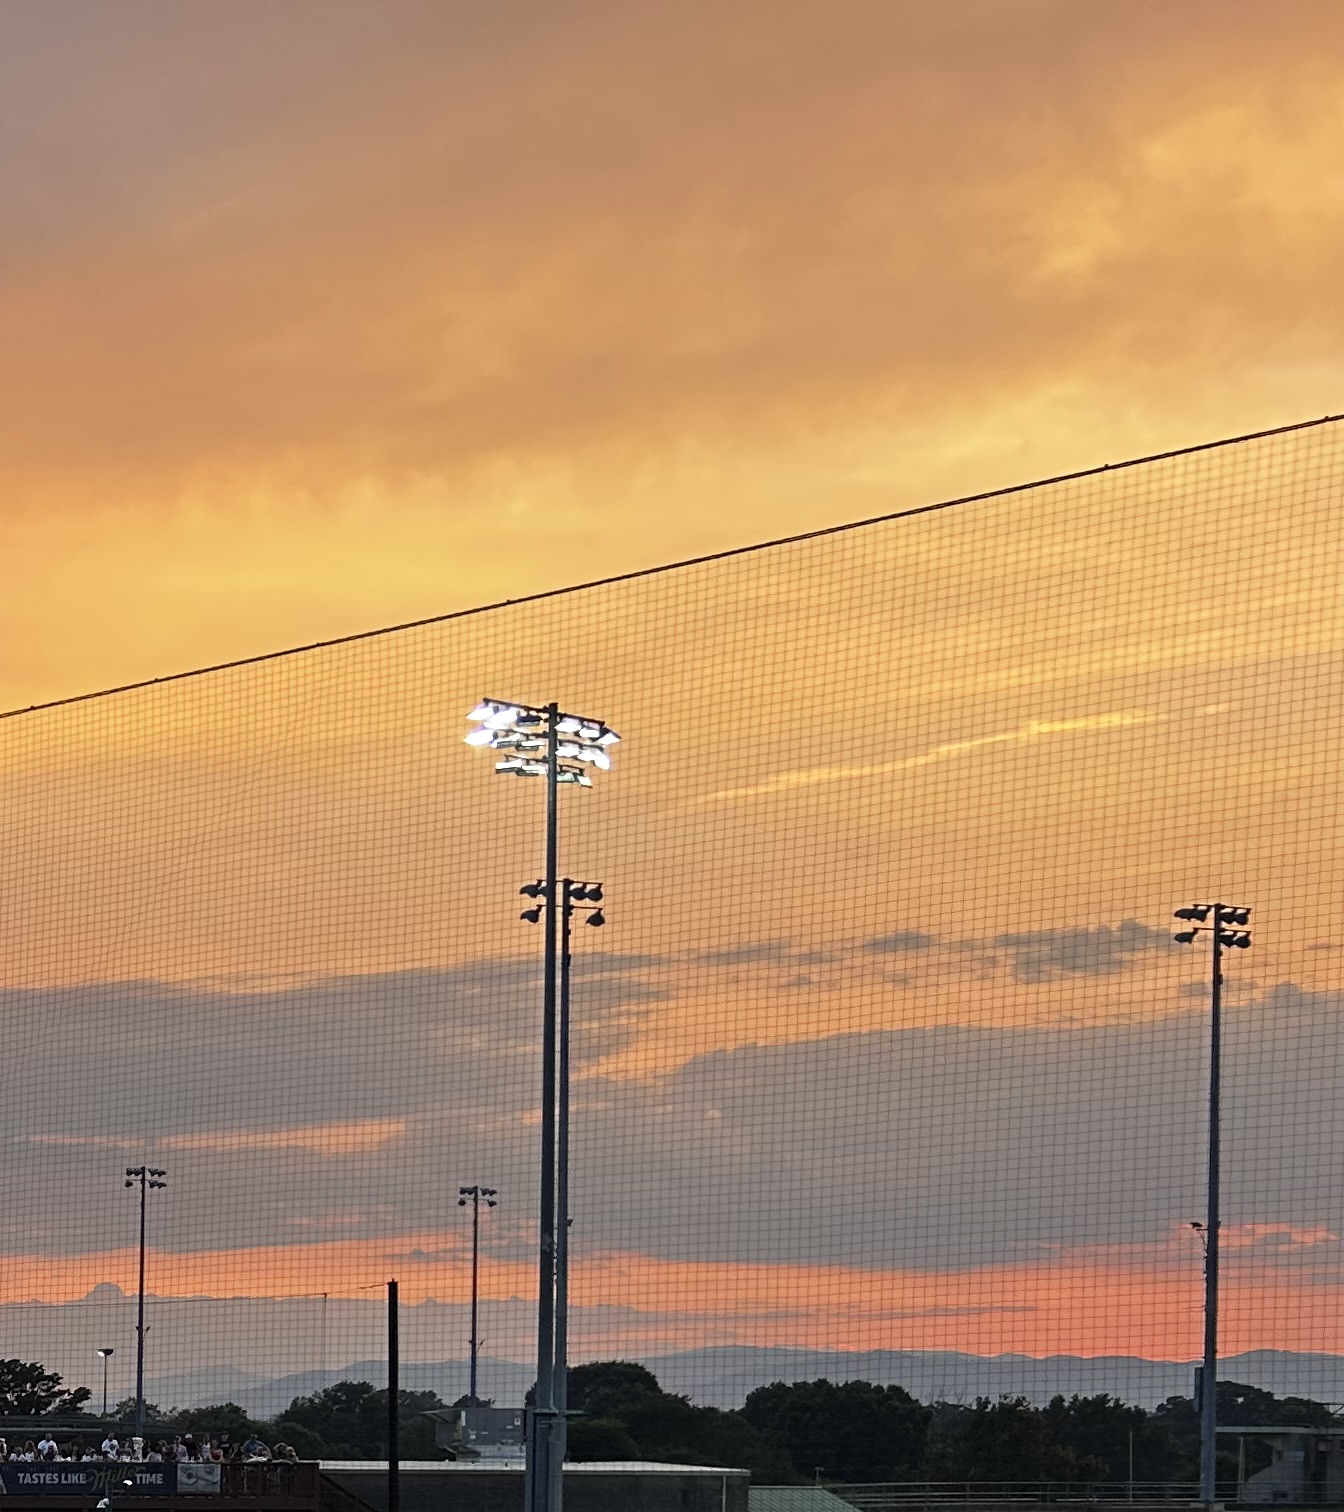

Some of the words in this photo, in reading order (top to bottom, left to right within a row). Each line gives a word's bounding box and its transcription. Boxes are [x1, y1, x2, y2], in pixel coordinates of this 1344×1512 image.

[17, 1472, 60, 1485] TASTES
[61, 1472, 87, 1485] LIKE
[134, 1472, 164, 1485] TIME
